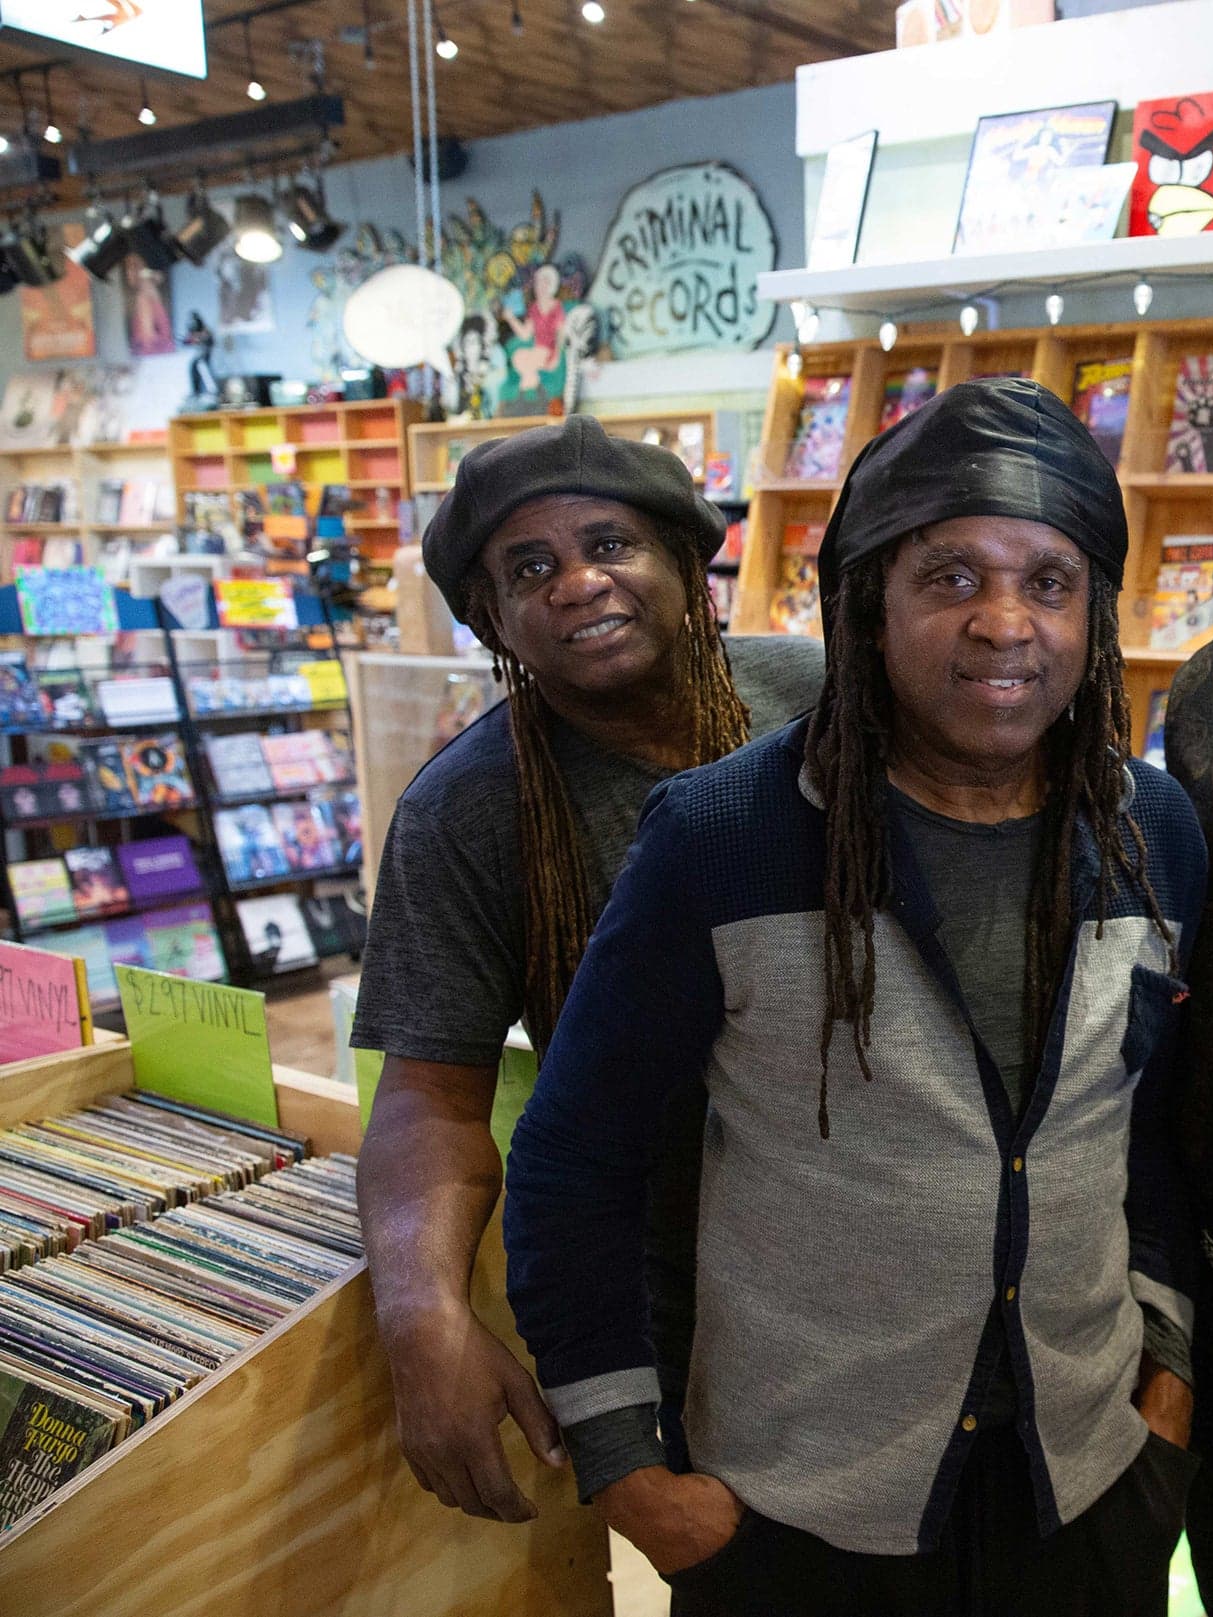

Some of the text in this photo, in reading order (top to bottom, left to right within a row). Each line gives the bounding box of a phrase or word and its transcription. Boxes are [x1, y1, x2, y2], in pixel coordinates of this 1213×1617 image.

[17, 976, 78, 1033] VINYL
[192, 985, 262, 1036] VINYL
[29, 1402, 87, 1446] Donna
[31, 1449, 61, 1480] The
